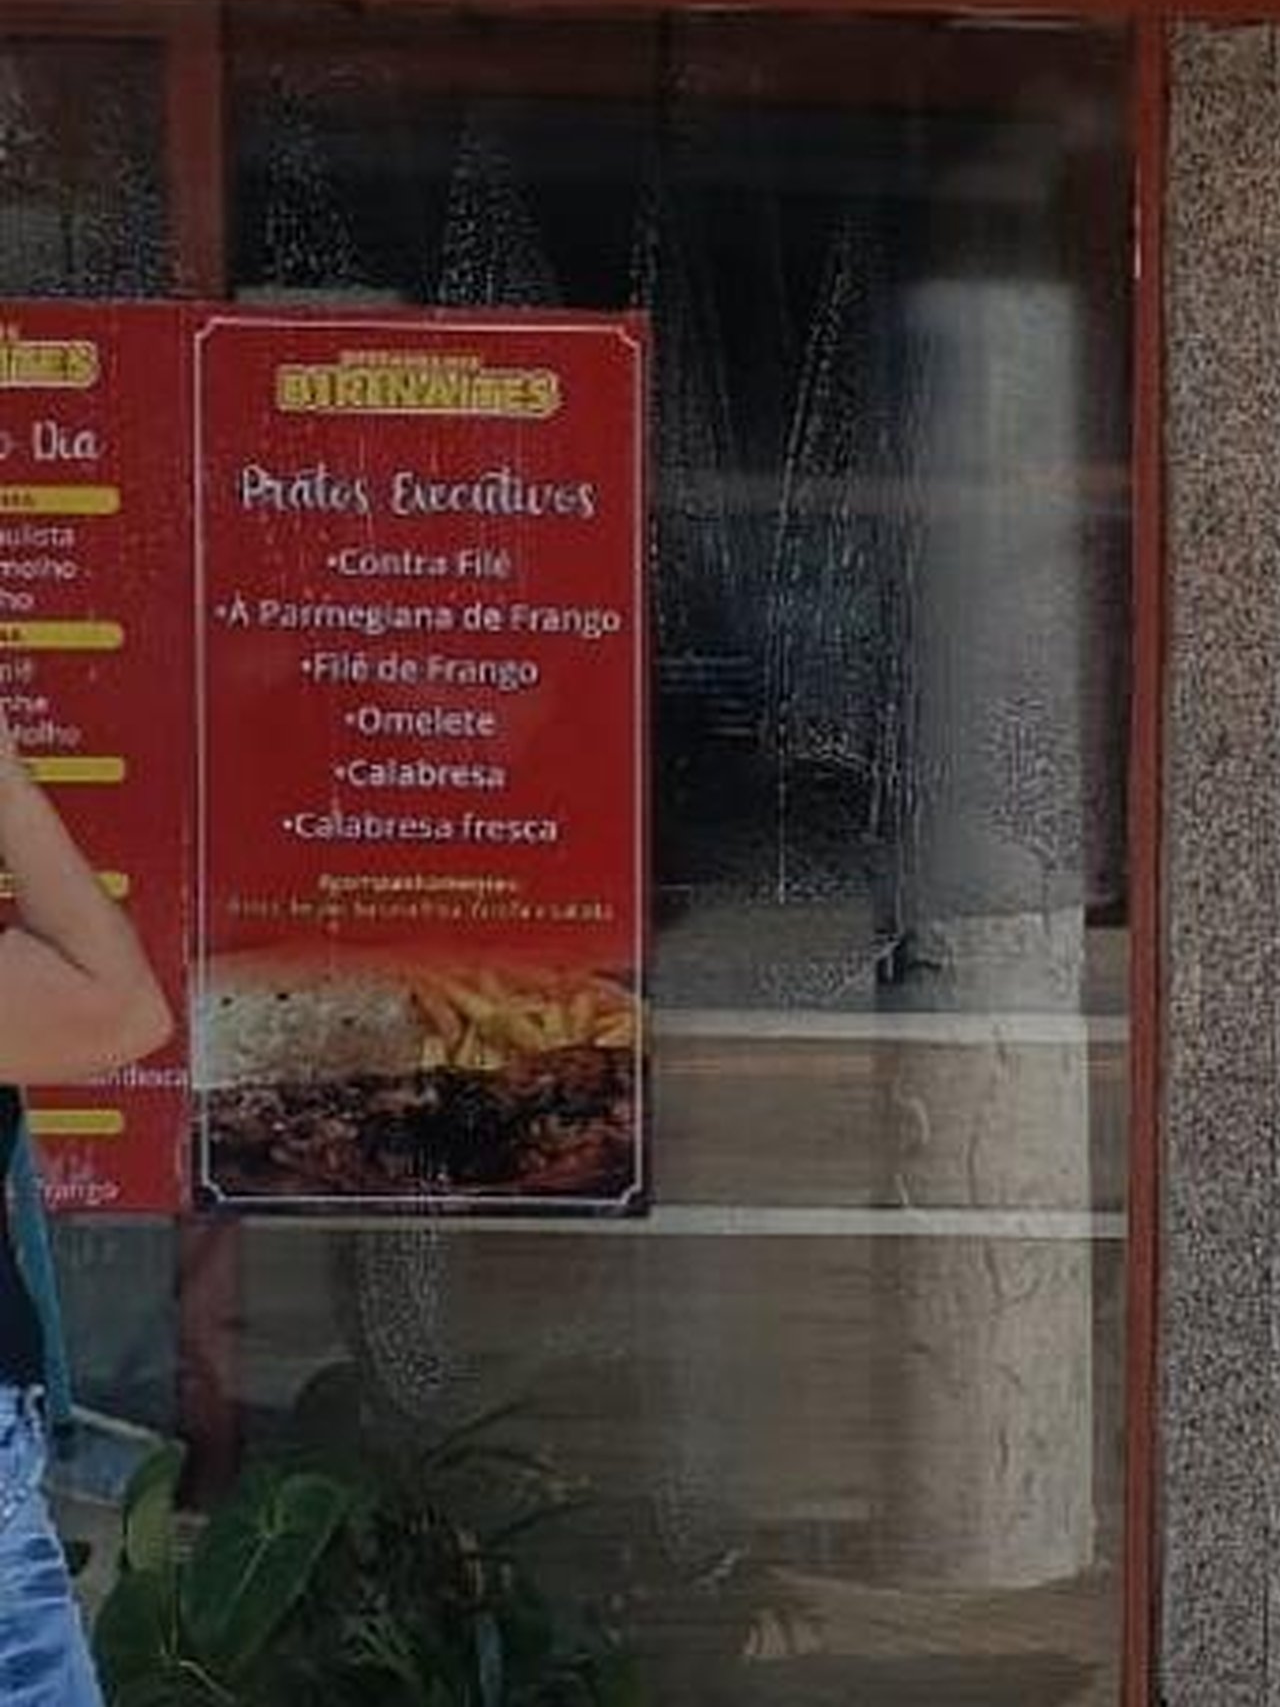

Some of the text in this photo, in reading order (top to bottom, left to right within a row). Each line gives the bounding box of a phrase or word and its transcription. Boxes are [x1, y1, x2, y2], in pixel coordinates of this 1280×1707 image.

[33, 420, 104, 461] Dia
[240, 462, 597, 516] Pratos Executivos
[338, 549, 448, 577] Contra
[259, 601, 454, 635] Parmegiana
[462, 602, 501, 631] de
[511, 604, 621, 639] Frango
[313, 652, 539, 691] Filé de Frango
[356, 704, 497, 738] Omelete
[347, 759, 506, 788] Calabresa
[295, 810, 558, 843] Calabresa fresca
